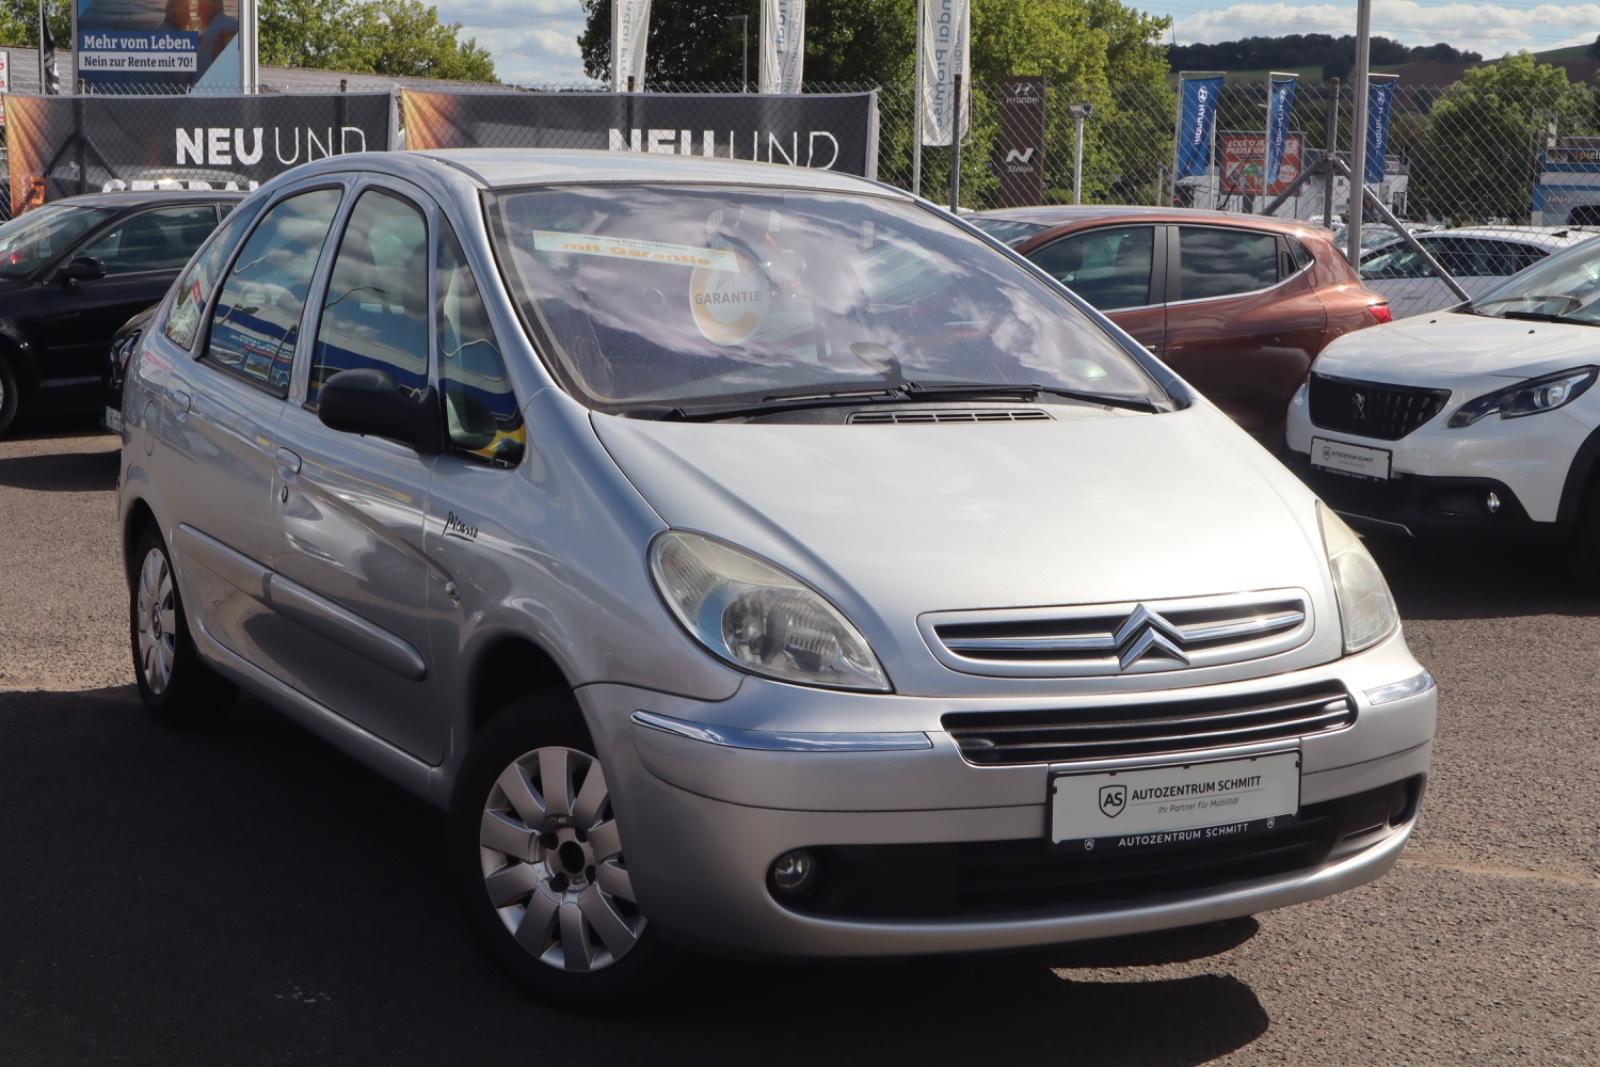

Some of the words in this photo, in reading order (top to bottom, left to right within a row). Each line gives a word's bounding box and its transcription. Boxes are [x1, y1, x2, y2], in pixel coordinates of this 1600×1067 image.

[84, 34, 118, 49] Mehr
[120, 38, 149, 49] vom
[151, 34, 195, 50] Leben.
[84, 56, 108, 67] Nein
[110, 58, 126, 67] zur
[128, 57, 157, 67] Rente
[158, 56, 175, 67] mit
[178, 57, 193, 68] 70!
[175, 127, 264, 166] NEU
[274, 126, 367, 165] UND
[730, 130, 838, 170] UND
[695, 290, 763, 305] GARANTIE
[1131, 782, 1216, 801] AUTOZENTRUM
[1218, 775, 1262, 792] SCHMITT
[1103, 792, 1123, 808] AS
[1169, 802, 1196, 813] Partner
[1210, 797, 1240, 808] Mobilität
[1118, 830, 1201, 847] AUTOZENTRUM
[1206, 822, 1249, 838] SCHMITT
